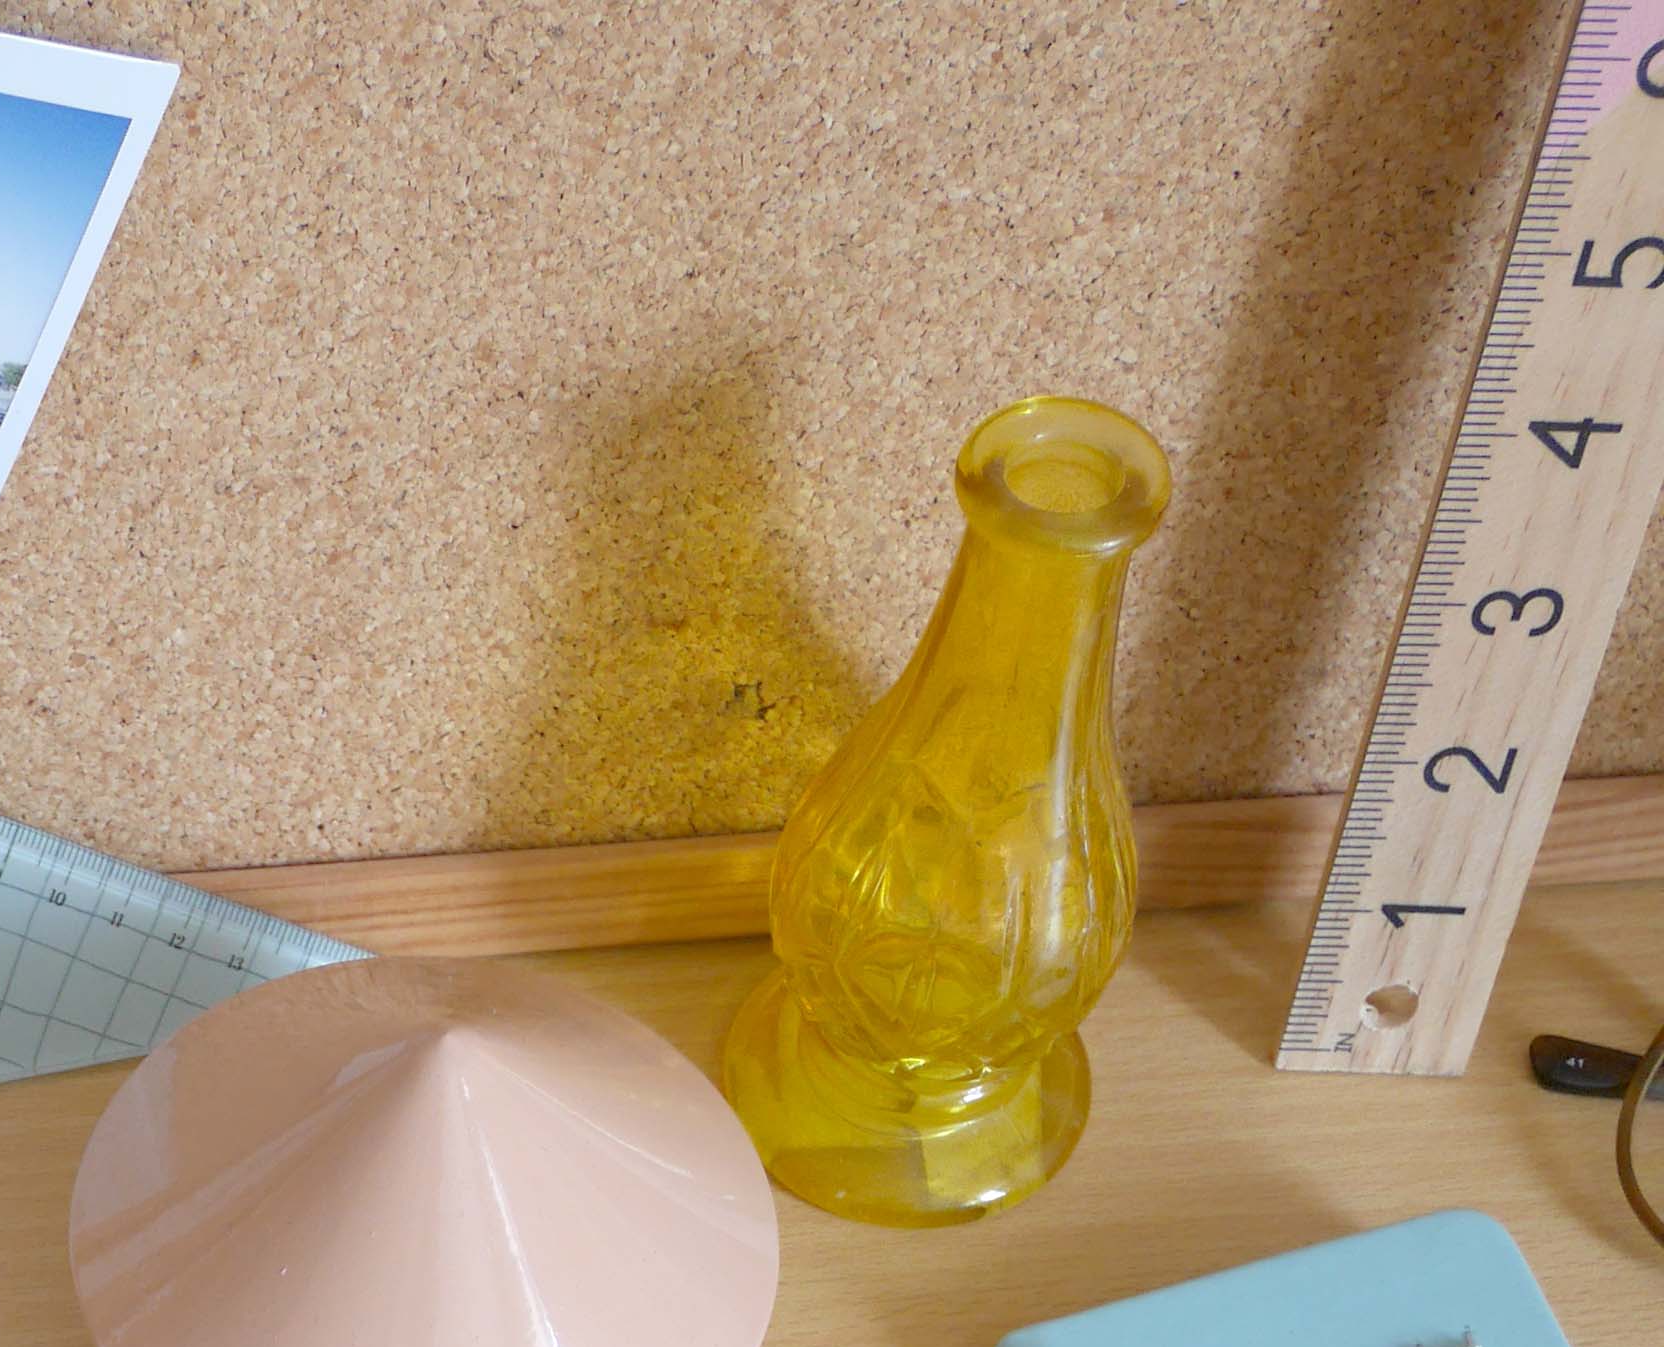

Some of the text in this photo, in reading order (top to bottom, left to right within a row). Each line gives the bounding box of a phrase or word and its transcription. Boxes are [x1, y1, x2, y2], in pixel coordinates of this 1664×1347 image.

[1380, 237, 1664, 929] 1 2 3 4 5
[48, 888, 66, 906] 10
[109, 910, 125, 927] 11
[168, 932, 186, 950] 12
[226, 954, 244, 972] 13
[1334, 1032, 1355, 1053] IN
